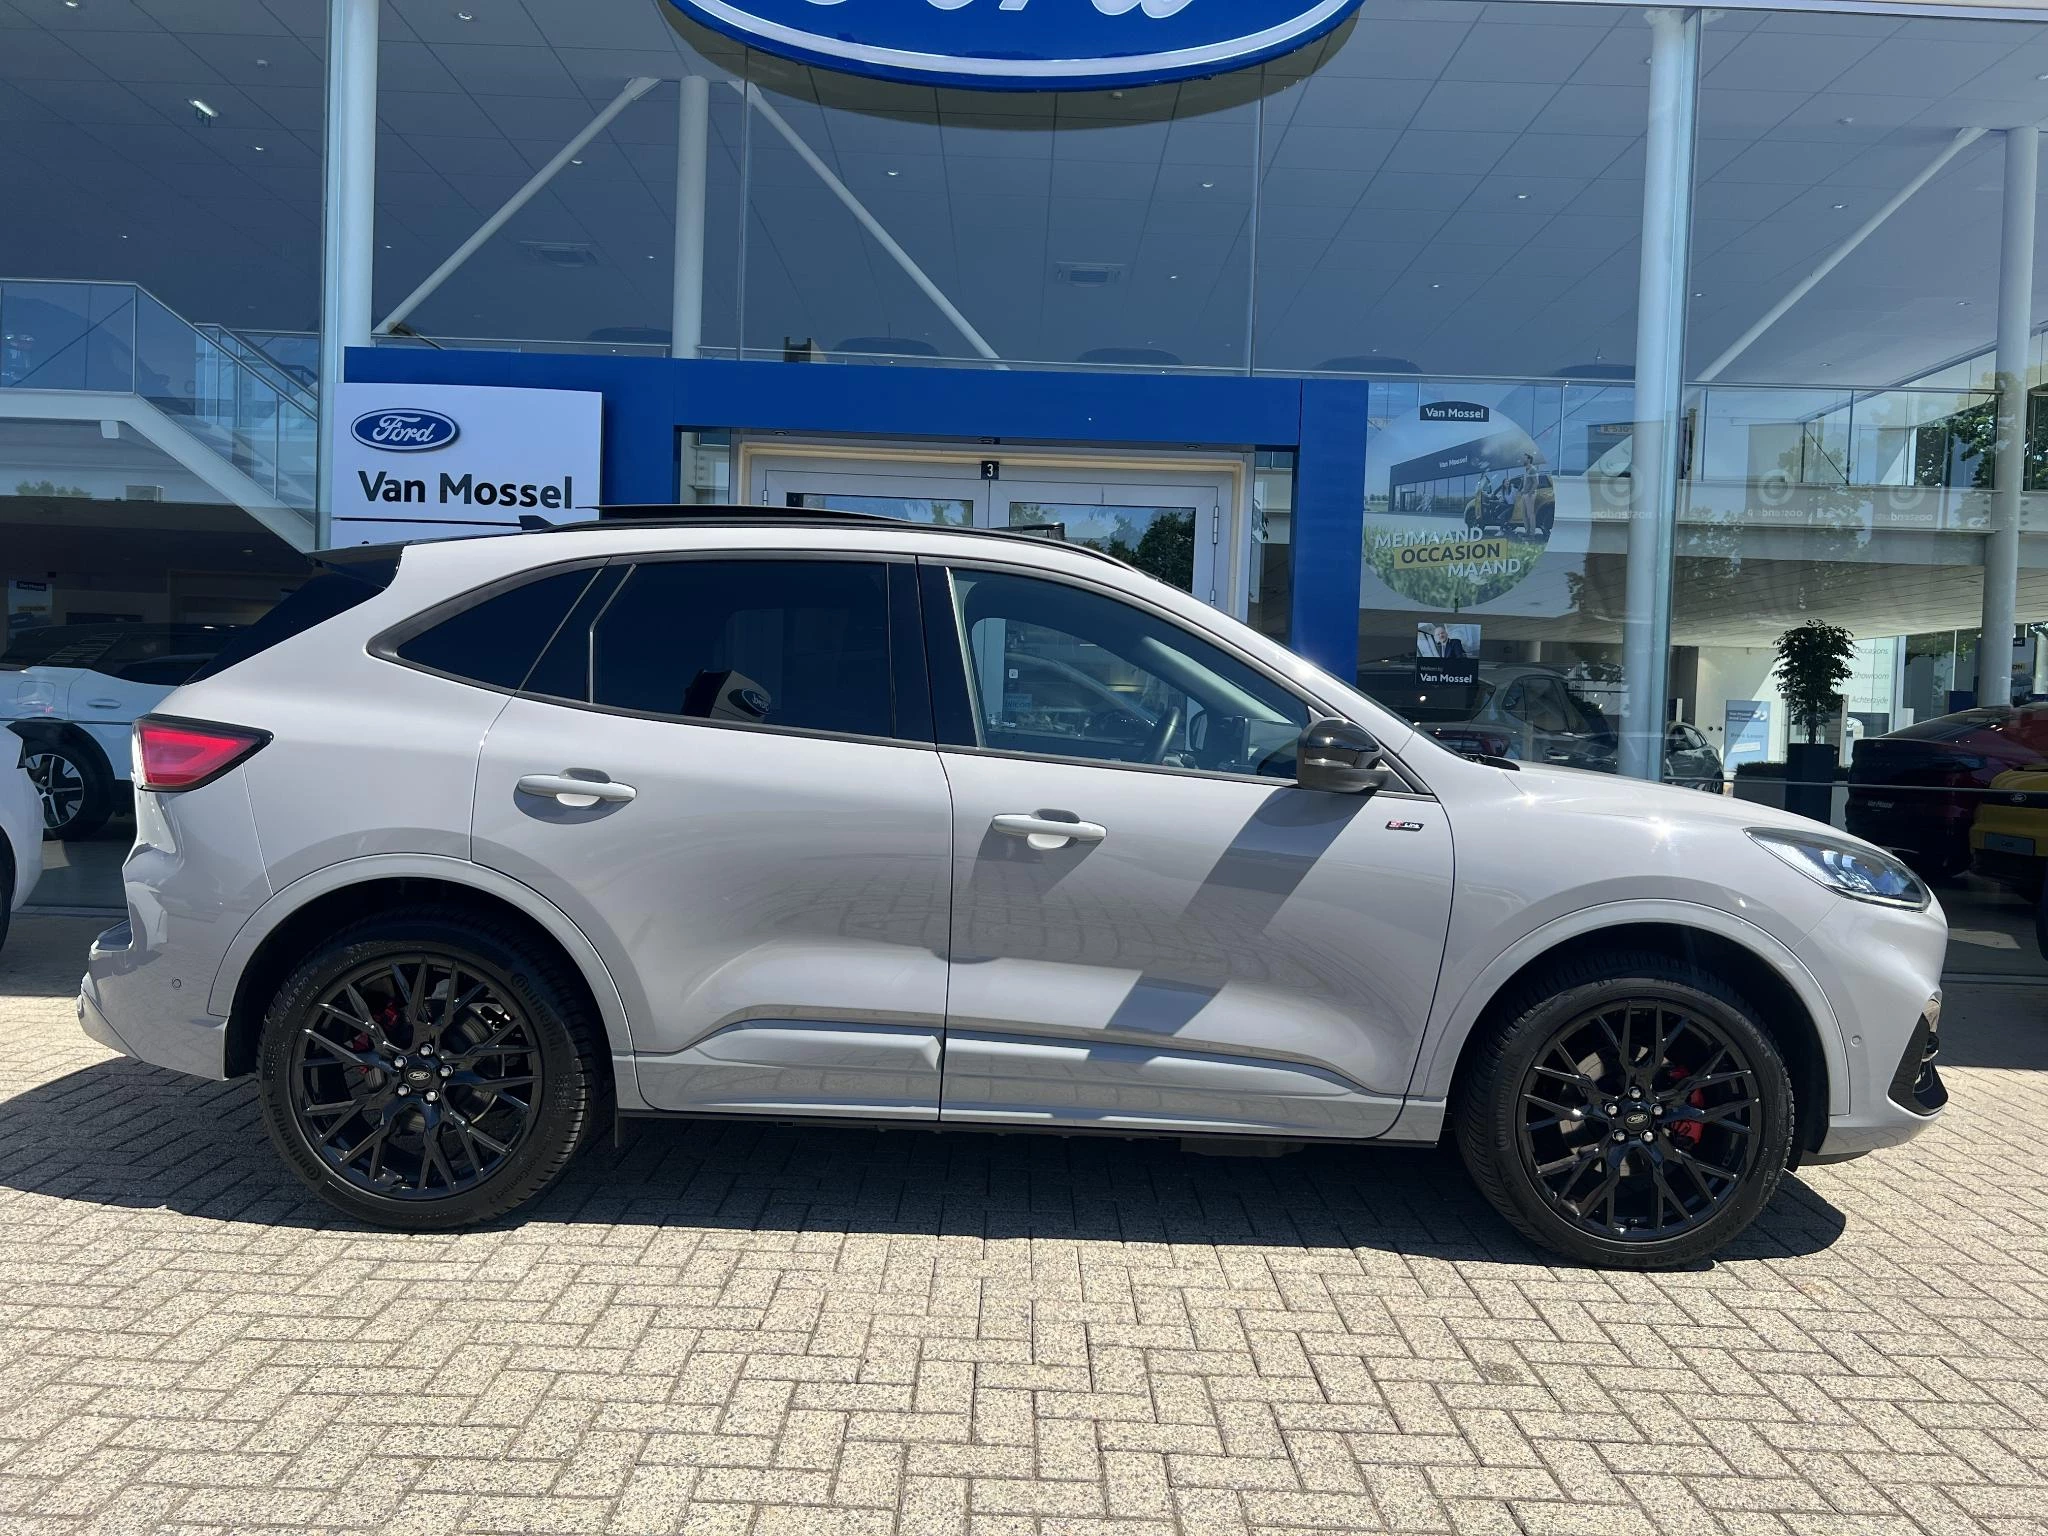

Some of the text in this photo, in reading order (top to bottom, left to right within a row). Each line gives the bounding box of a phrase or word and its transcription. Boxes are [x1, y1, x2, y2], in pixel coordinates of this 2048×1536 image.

[1426, 408, 1484, 419] Van Mossel
[371, 414, 437, 442] Ford
[987, 463, 994, 477] 3
[357, 470, 572, 509] Van Mossel
[1375, 527, 1483, 549] MEIMAAND
[1401, 543, 1500, 564] OCCASION
[1448, 558, 1521, 578] MAAND
[1420, 673, 1473, 684] Van Mossel
[1853, 671, 1889, 680] Showroom
